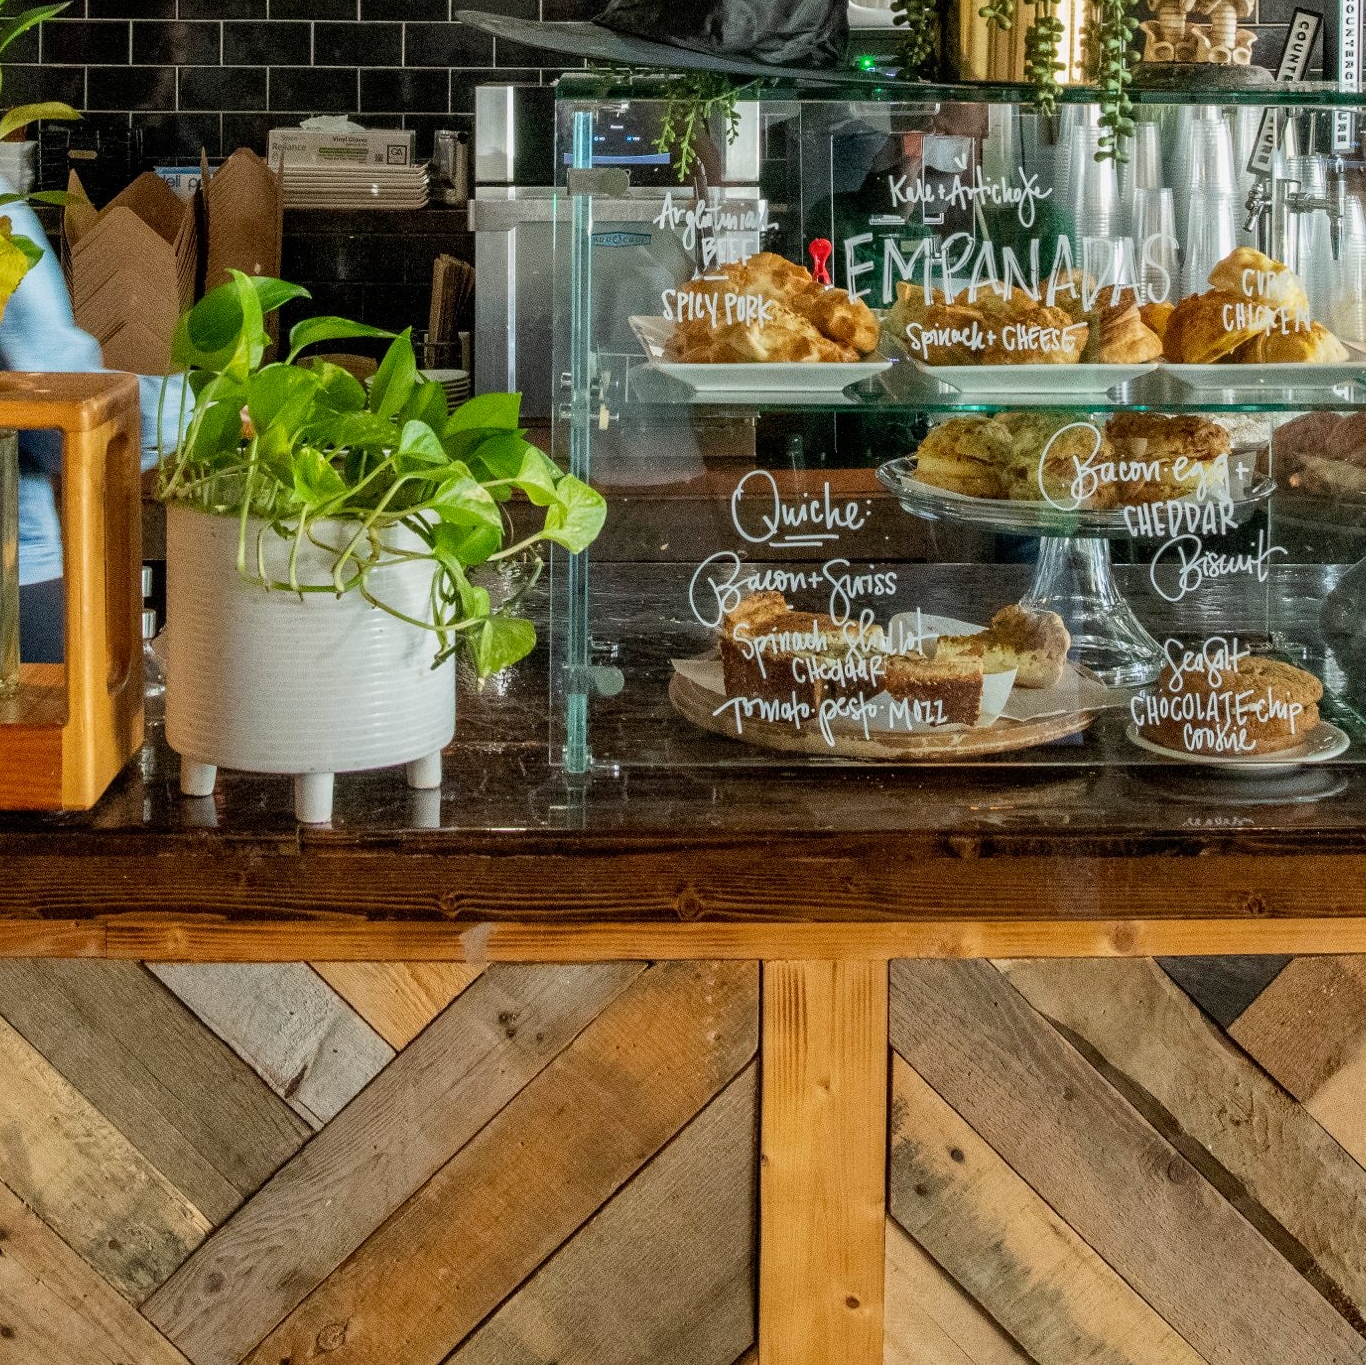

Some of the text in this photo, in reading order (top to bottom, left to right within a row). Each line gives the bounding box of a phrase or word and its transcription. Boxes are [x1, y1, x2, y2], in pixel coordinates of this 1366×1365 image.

[702, 237, 756, 267] BEEF
[843, 232, 1179, 312] EMPANADAS
[661, 288, 775, 329] SPICY PORK
[1222, 302, 1312, 336] CHICKEN
[1001, 321, 1088, 353] CHEESE
[1124, 499, 1238, 537] CHEDDAR
[1151, 529, 1288, 601] Biscuit
[1130, 689, 1255, 726] CHOCOLATE
